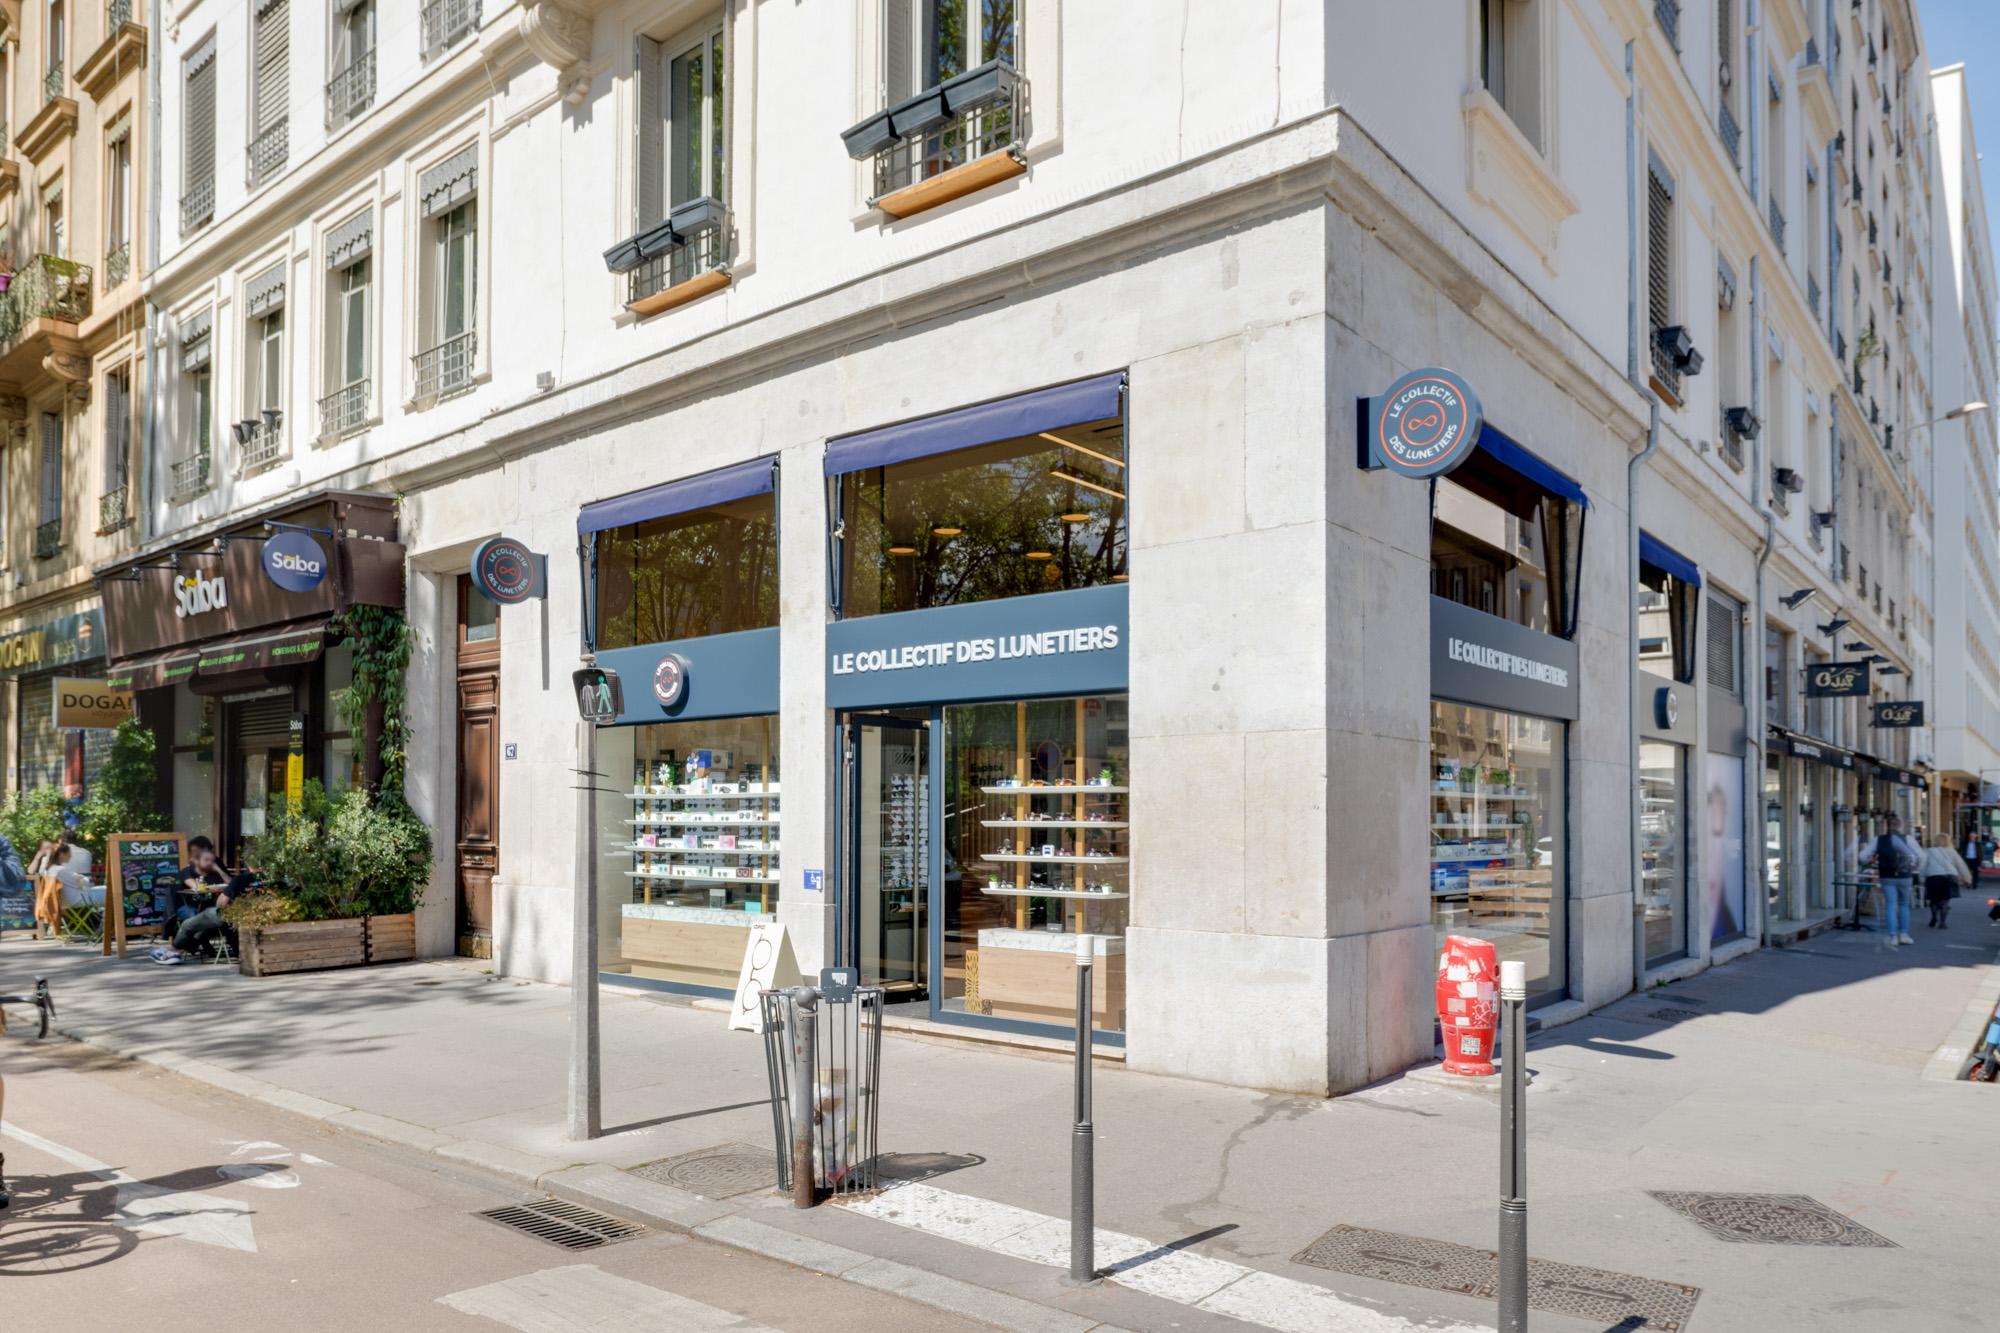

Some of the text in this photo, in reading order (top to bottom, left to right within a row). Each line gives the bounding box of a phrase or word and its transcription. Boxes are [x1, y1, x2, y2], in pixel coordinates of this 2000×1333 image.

[1389, 385, 1457, 418] LE COLLECTIF
[1389, 424, 1457, 460] DES LUNETIERS
[271, 551, 320, 573] Saba
[174, 569, 228, 618] Saba
[832, 625, 1120, 675] LE COLLECTIF DES LUNETIERS
[1449, 637, 1463, 661] LE
[1462, 642, 1512, 673] COLLECTIF
[1511, 655, 1528, 677] DES
